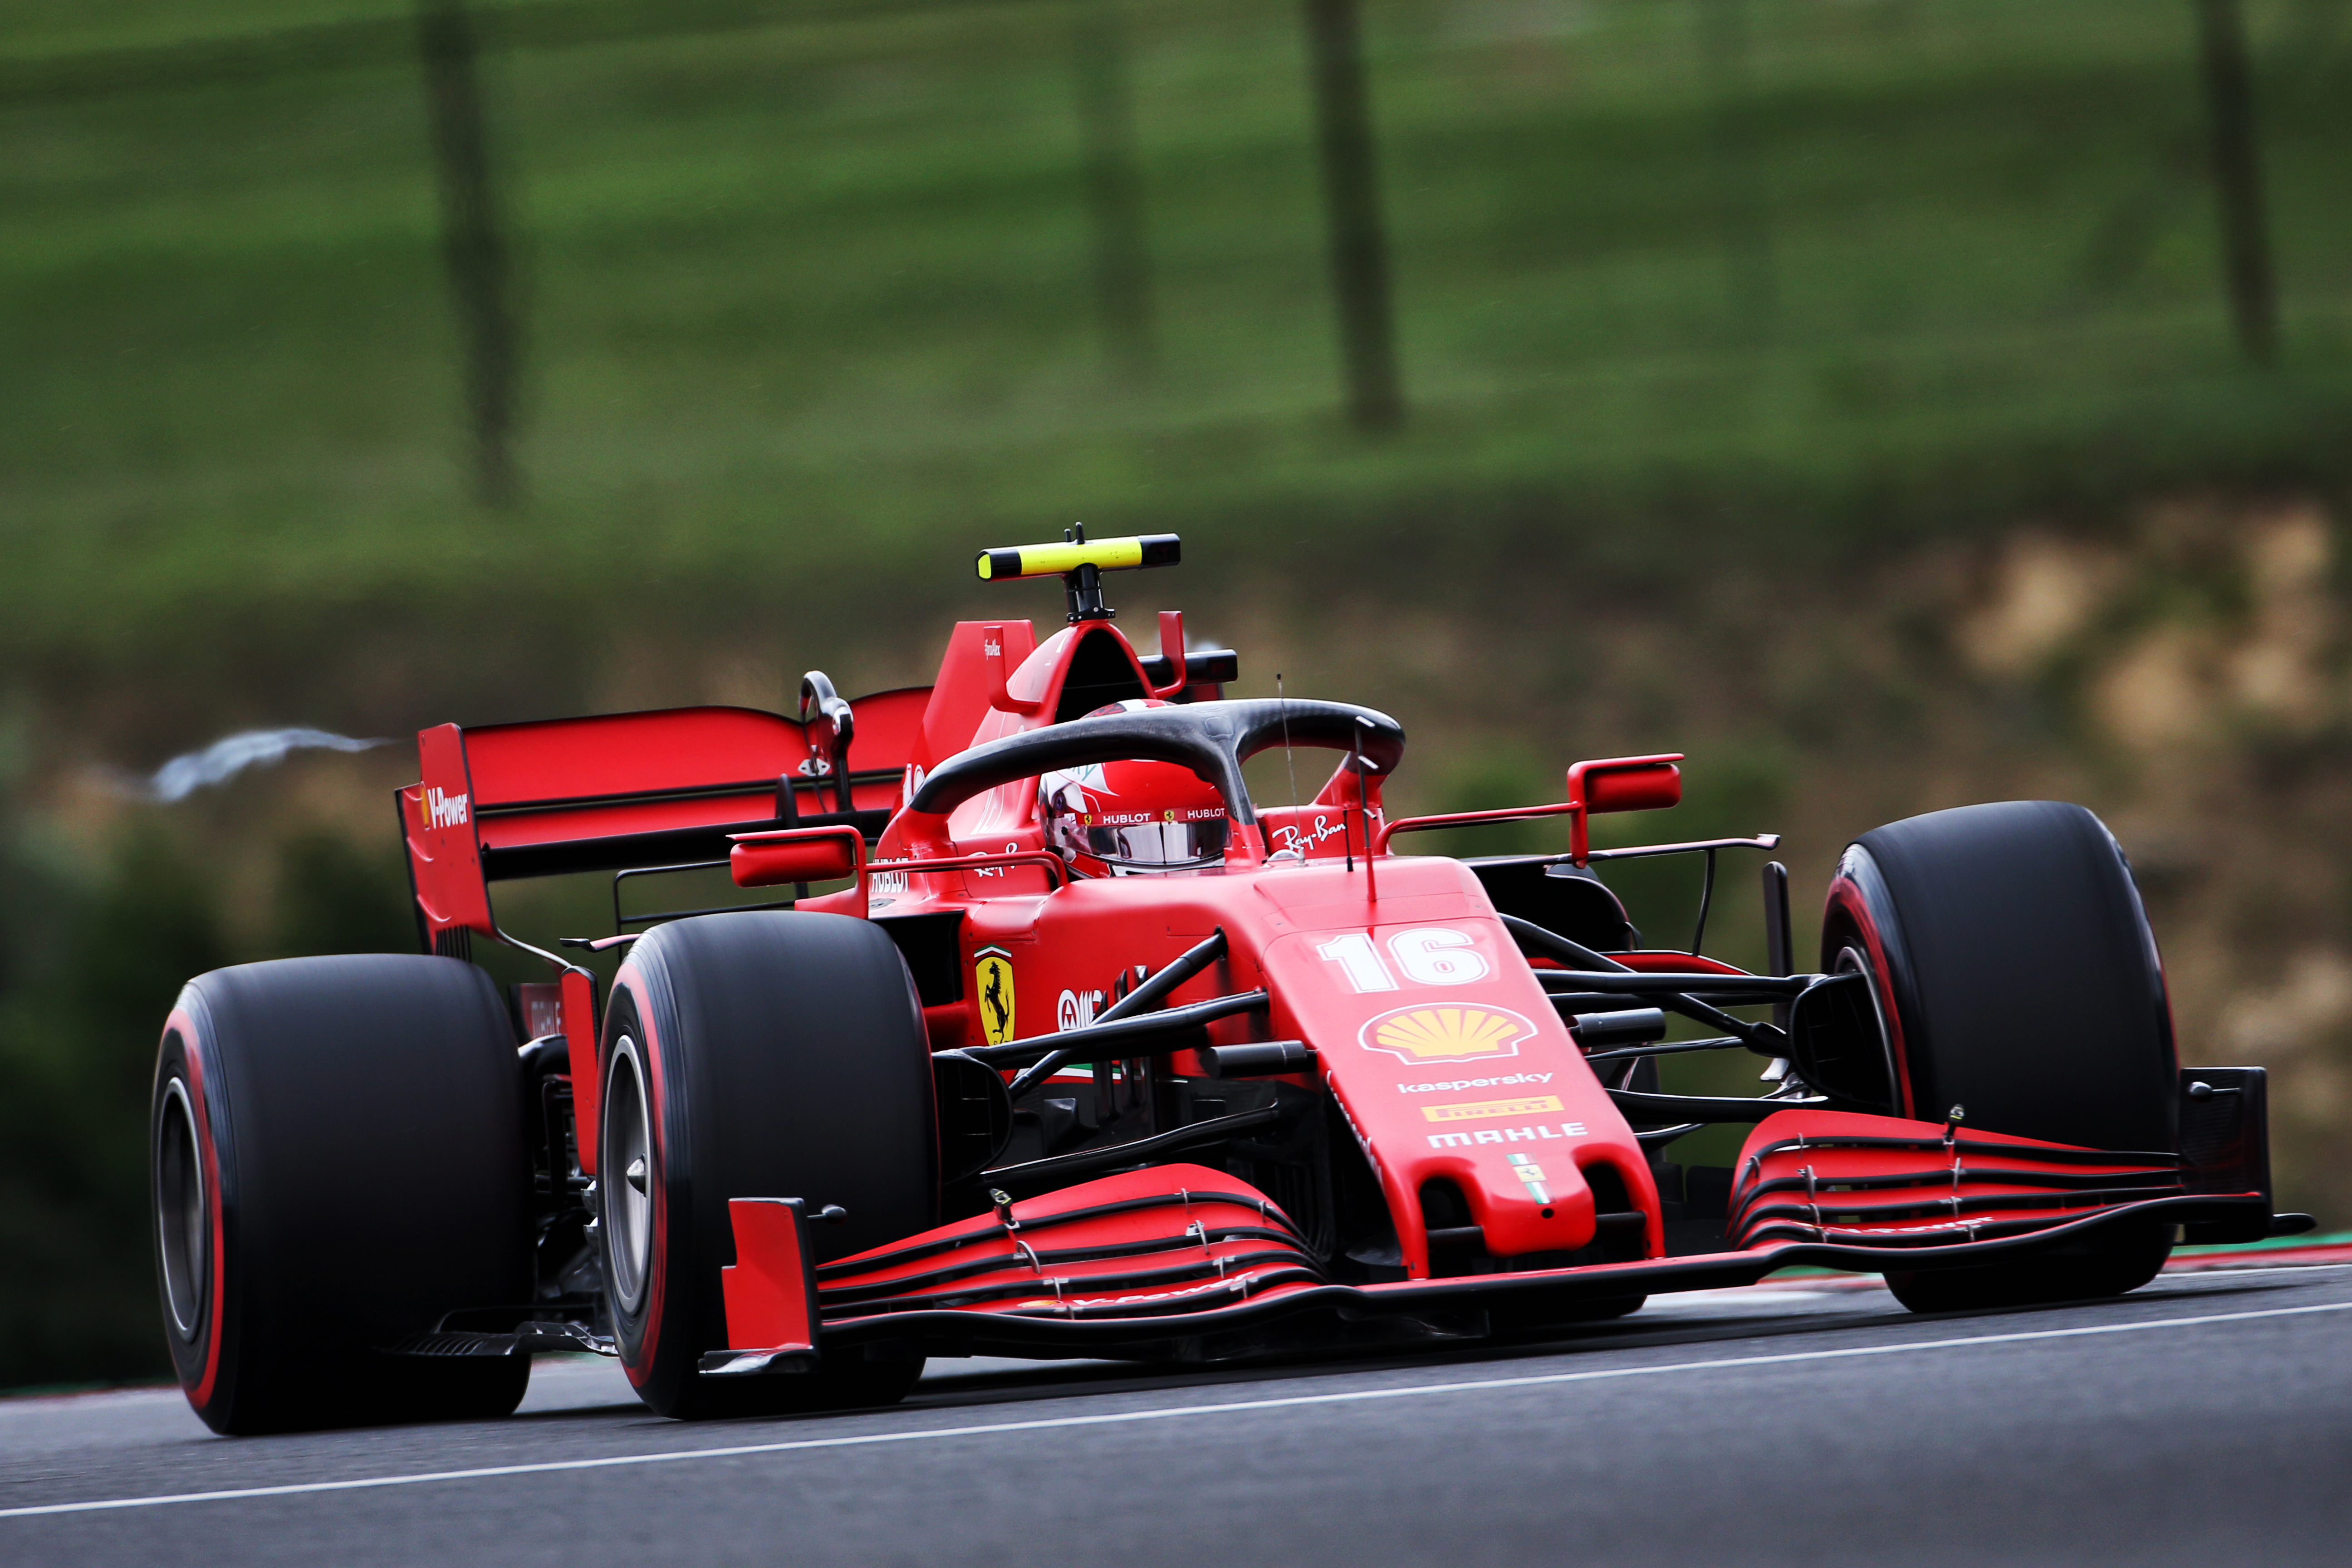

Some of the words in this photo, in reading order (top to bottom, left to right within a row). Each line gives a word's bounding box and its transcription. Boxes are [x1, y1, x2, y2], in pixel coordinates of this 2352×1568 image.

[427, 786, 468, 829] V-Power
[1103, 813, 1151, 824] HUBLOT
[1187, 808, 1225, 819] HUBLOT
[1272, 815, 1347, 850] Ray-Ban
[1315, 927, 1490, 994] 16
[1396, 1072, 1553, 1094] kaspersky
[1434, 1099, 1548, 1118] PIRELLI
[1426, 1122, 1589, 1149] MAHLE
[1073, 1271, 1254, 1306] V-Power
